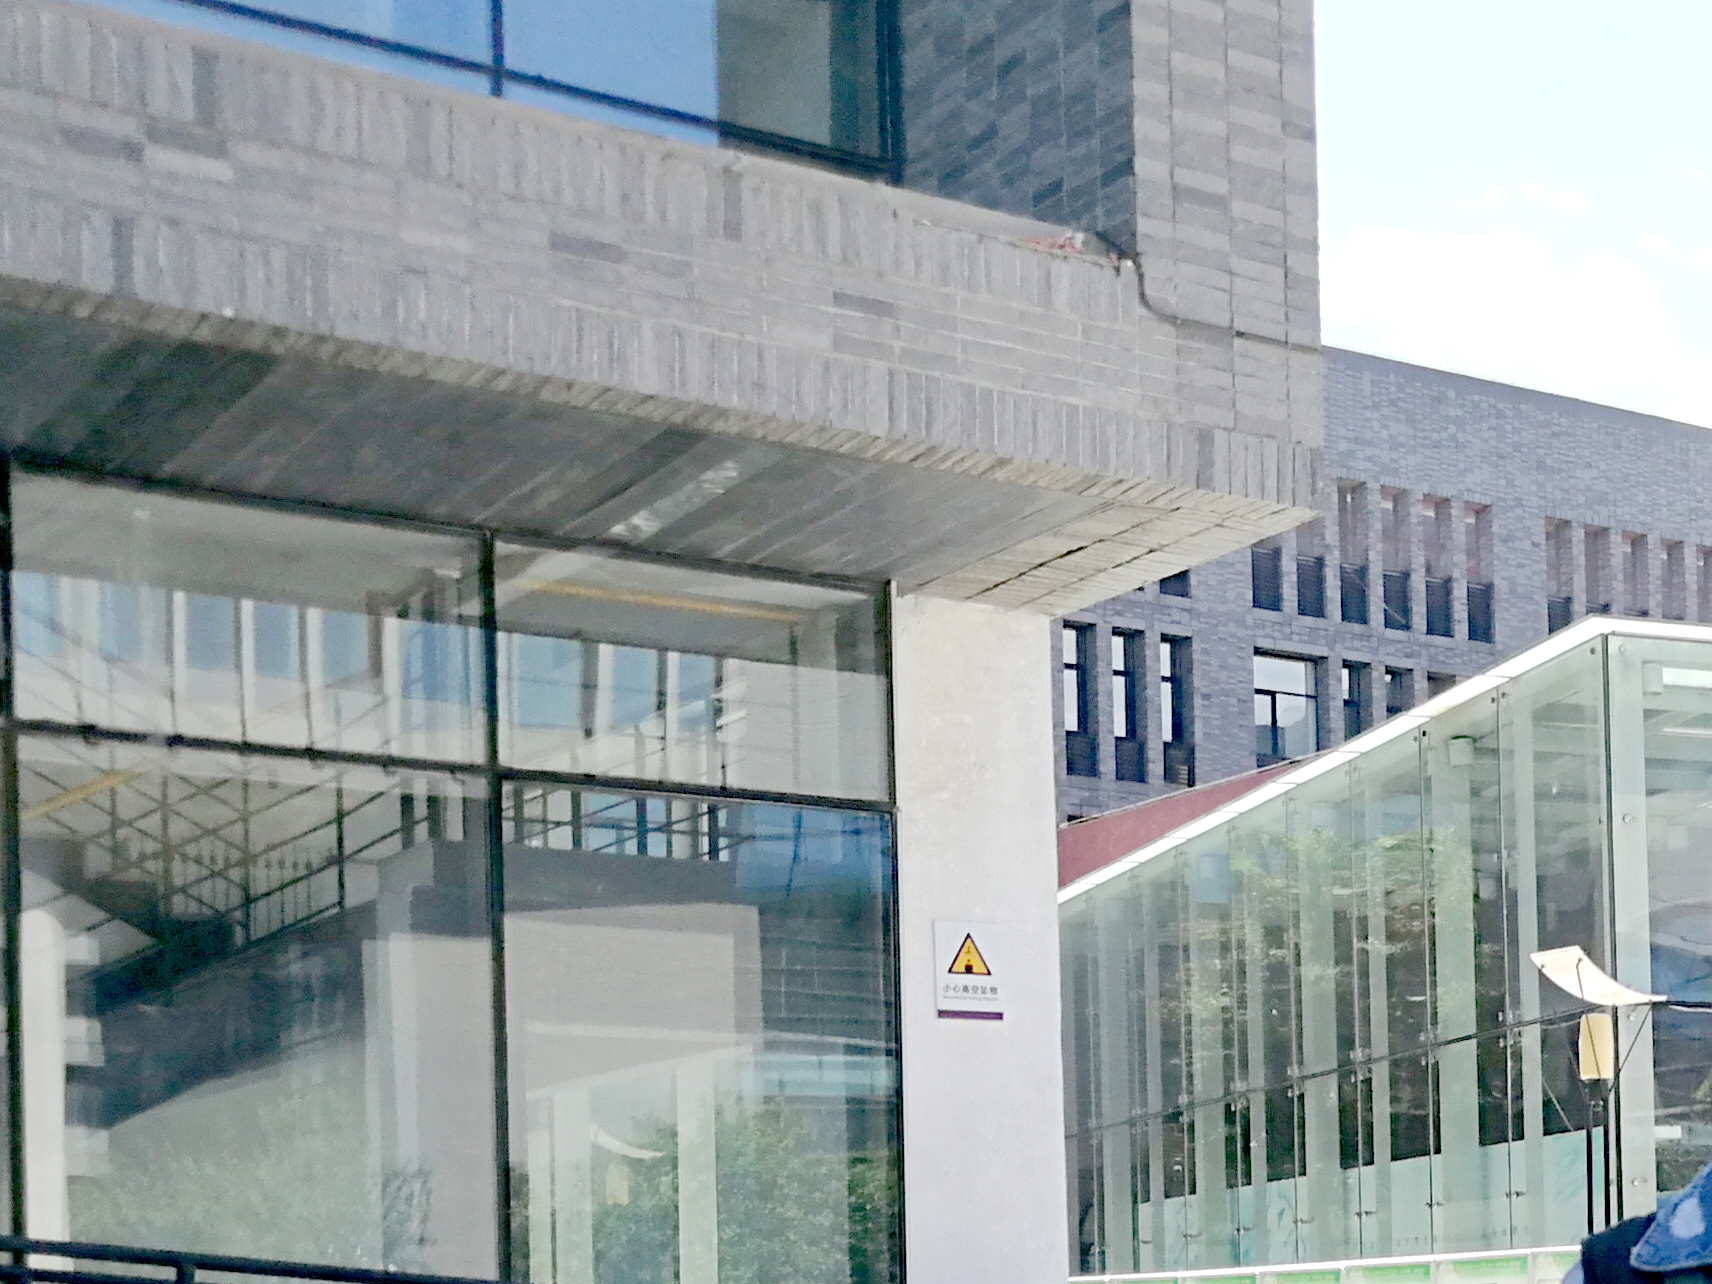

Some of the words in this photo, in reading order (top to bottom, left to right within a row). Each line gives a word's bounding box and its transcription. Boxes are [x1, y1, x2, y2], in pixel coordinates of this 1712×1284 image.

[943, 985, 998, 995] 小心高空坠物
